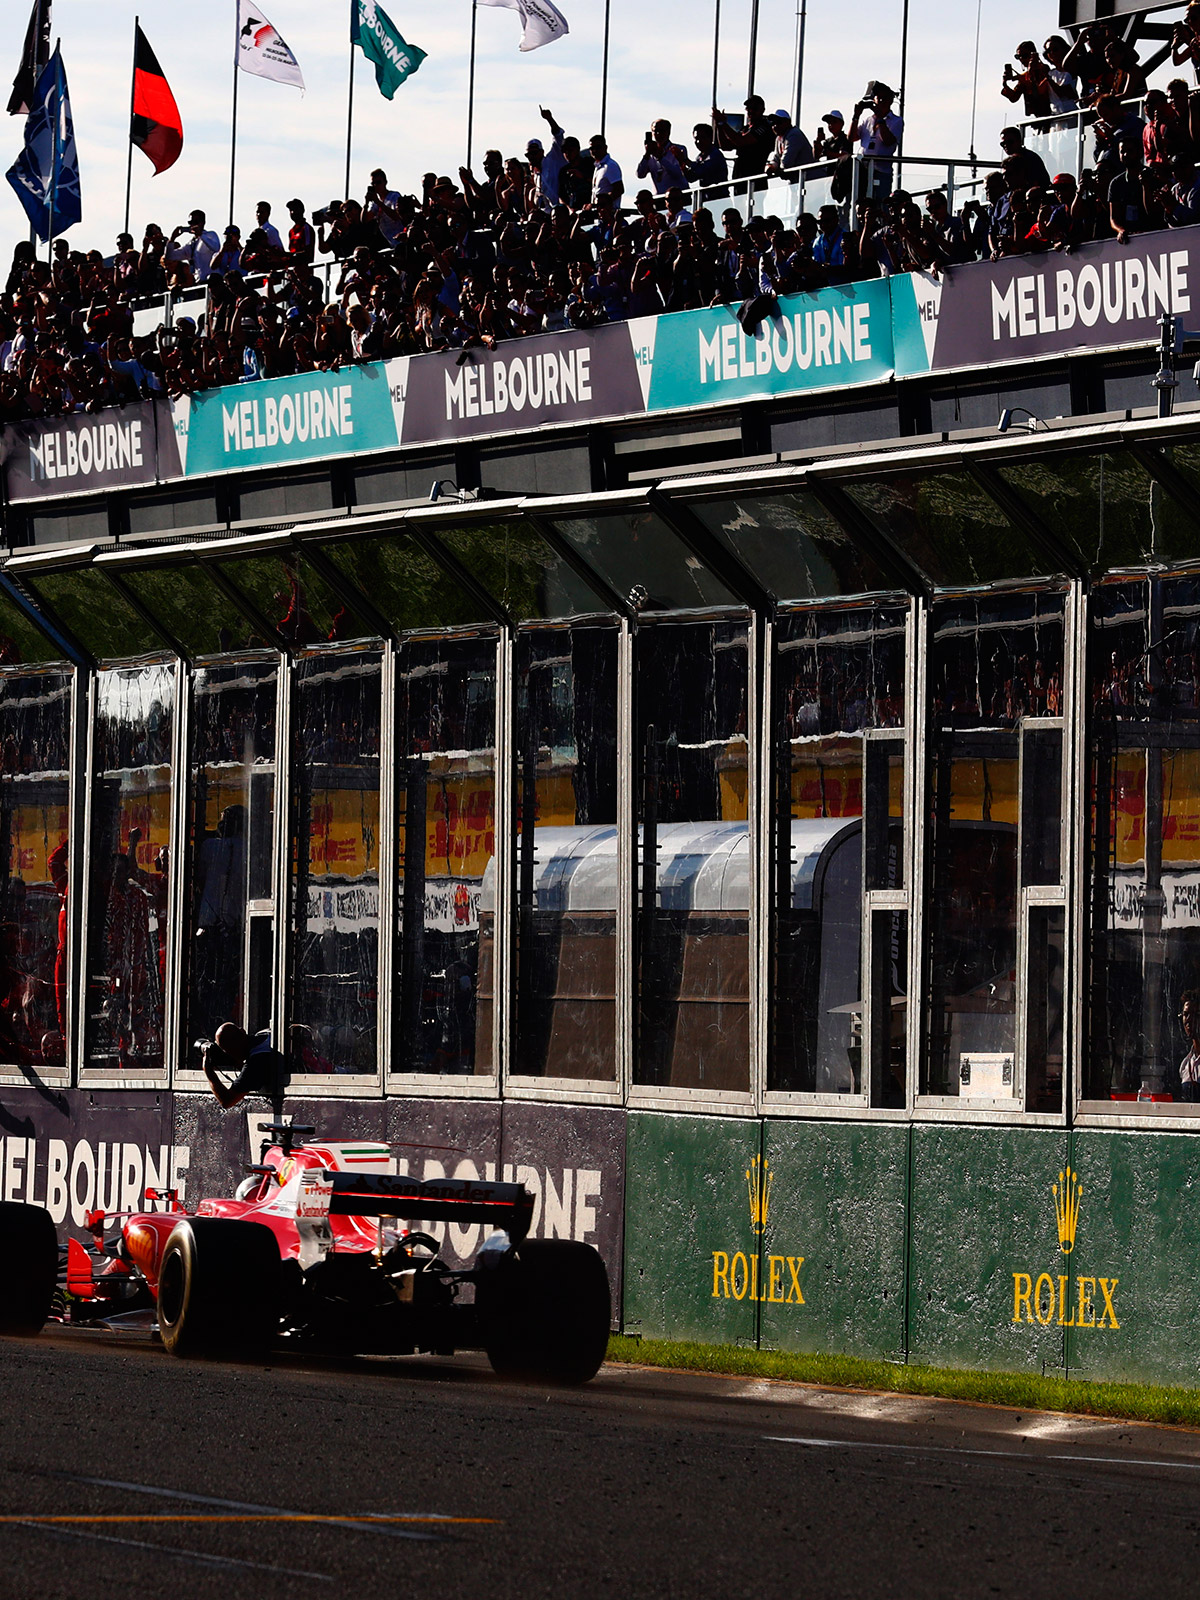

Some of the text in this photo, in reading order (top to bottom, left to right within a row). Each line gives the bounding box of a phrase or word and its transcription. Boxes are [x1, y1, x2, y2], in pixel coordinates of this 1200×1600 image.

[918, 299, 939, 321] MEL
[990, 250, 1191, 341] MELBOURNE
[634, 344, 654, 366] MEL
[698, 302, 872, 384] MELBOURNE
[389, 384, 405, 403] MEL
[444, 346, 593, 421] MELBOURNE
[222, 384, 353, 452] MELBOURNE
[28, 420, 144, 482] MELBOURNE
[302, 1201, 330, 1217] Santander
[375, 1176, 495, 1201] Santander
[711, 1250, 806, 1304] ROLEX
[1011, 1272, 1121, 1330] ROLEX
